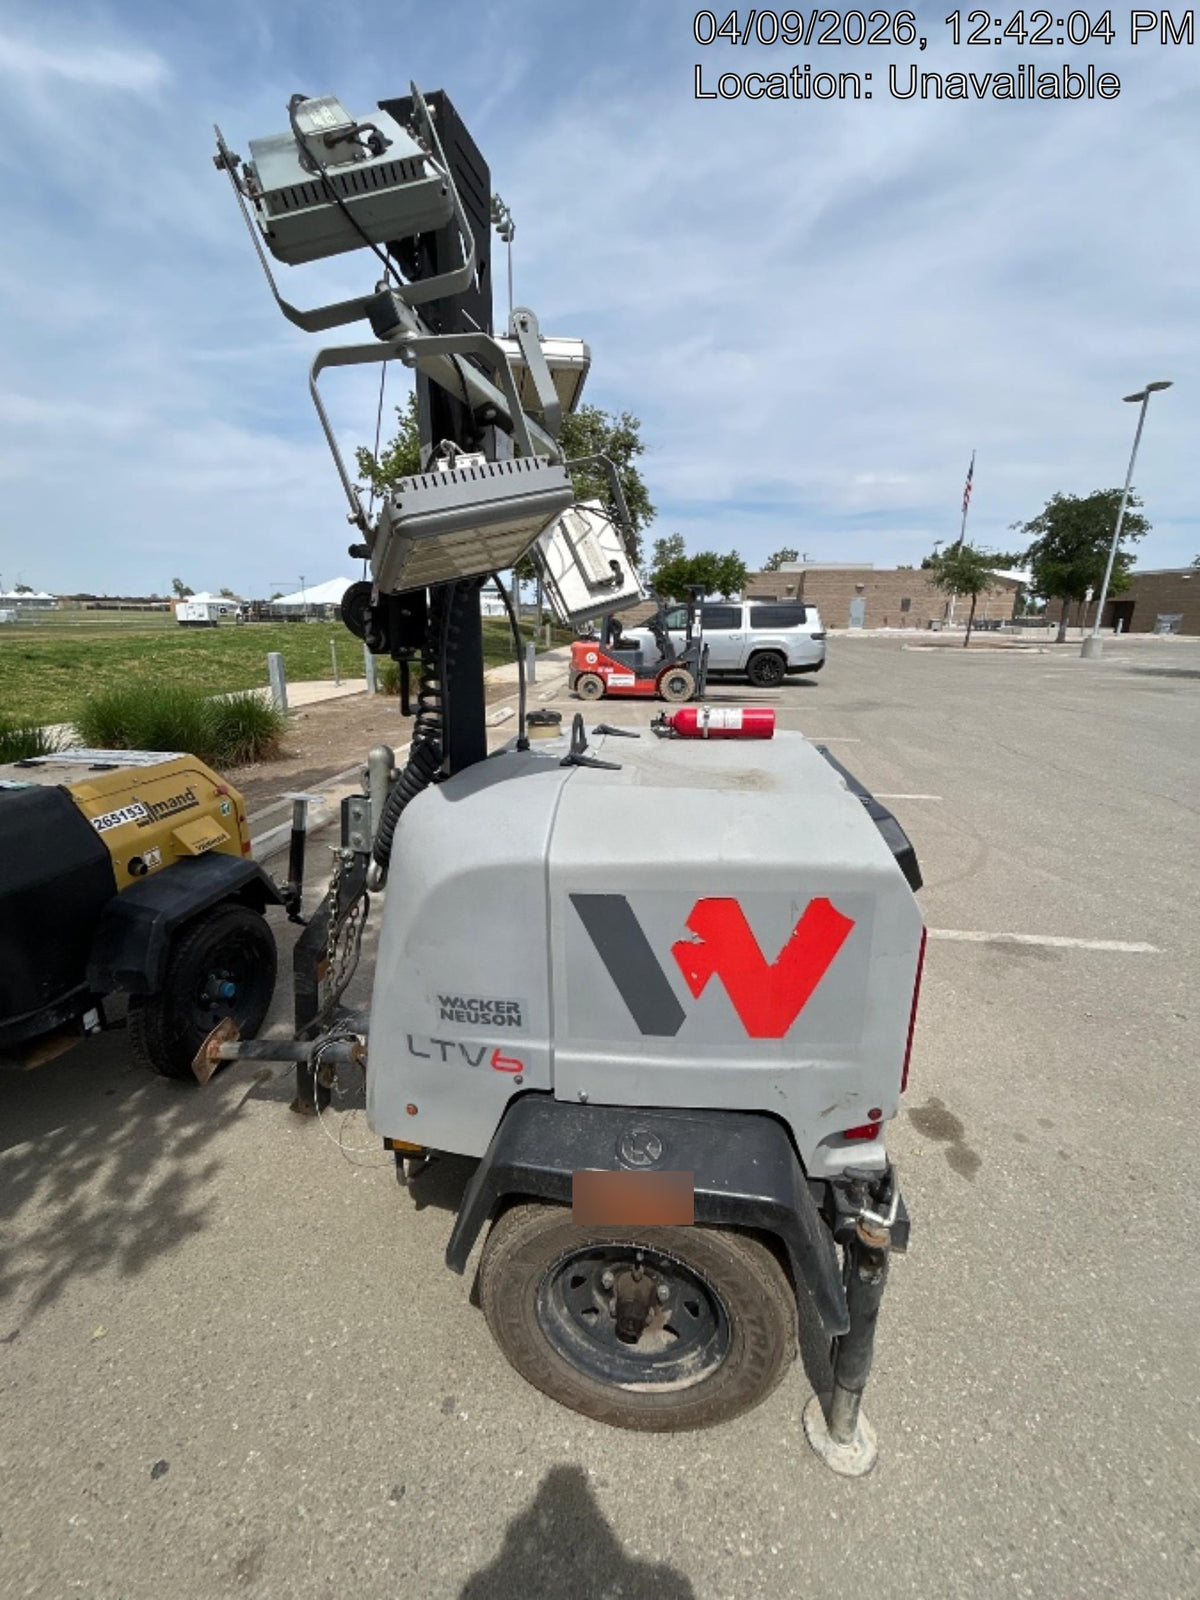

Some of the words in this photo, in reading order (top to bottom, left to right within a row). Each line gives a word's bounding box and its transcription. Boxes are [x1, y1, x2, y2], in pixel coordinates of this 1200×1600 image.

[437, 994, 521, 1015] WACKER
[439, 1007, 522, 1028] NEUSON
[406, 1033, 524, 1073] LTV6
